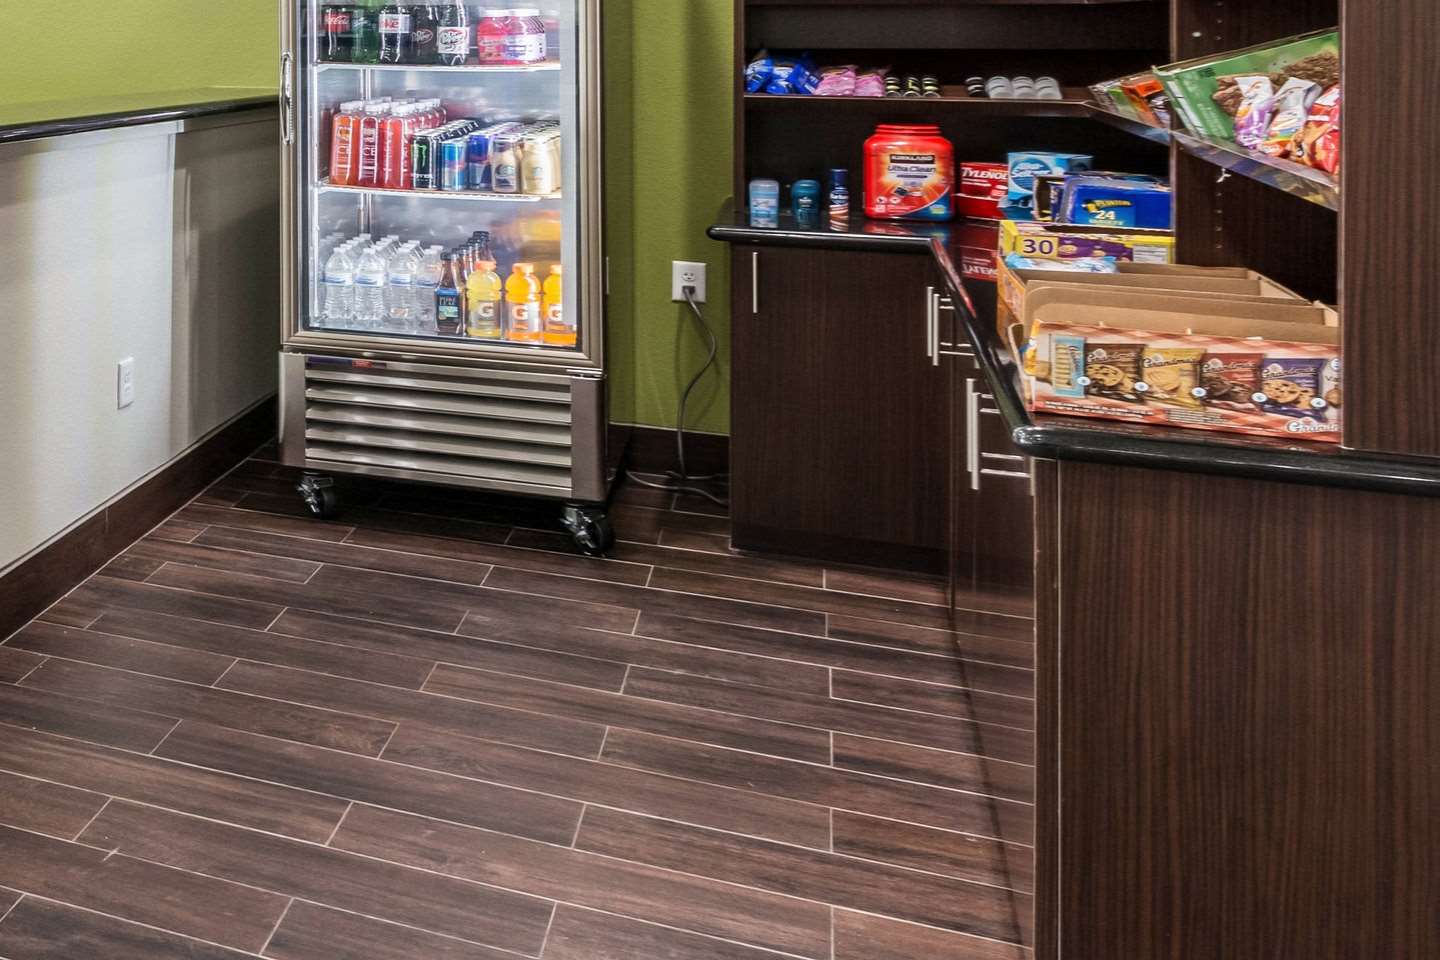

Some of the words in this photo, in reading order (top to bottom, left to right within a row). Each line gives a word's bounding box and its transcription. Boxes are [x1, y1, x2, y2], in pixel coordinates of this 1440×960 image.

[962, 167, 1008, 180] TYLENOL
[1094, 210, 1116, 220] 24
[1023, 239, 1054, 255] 30
